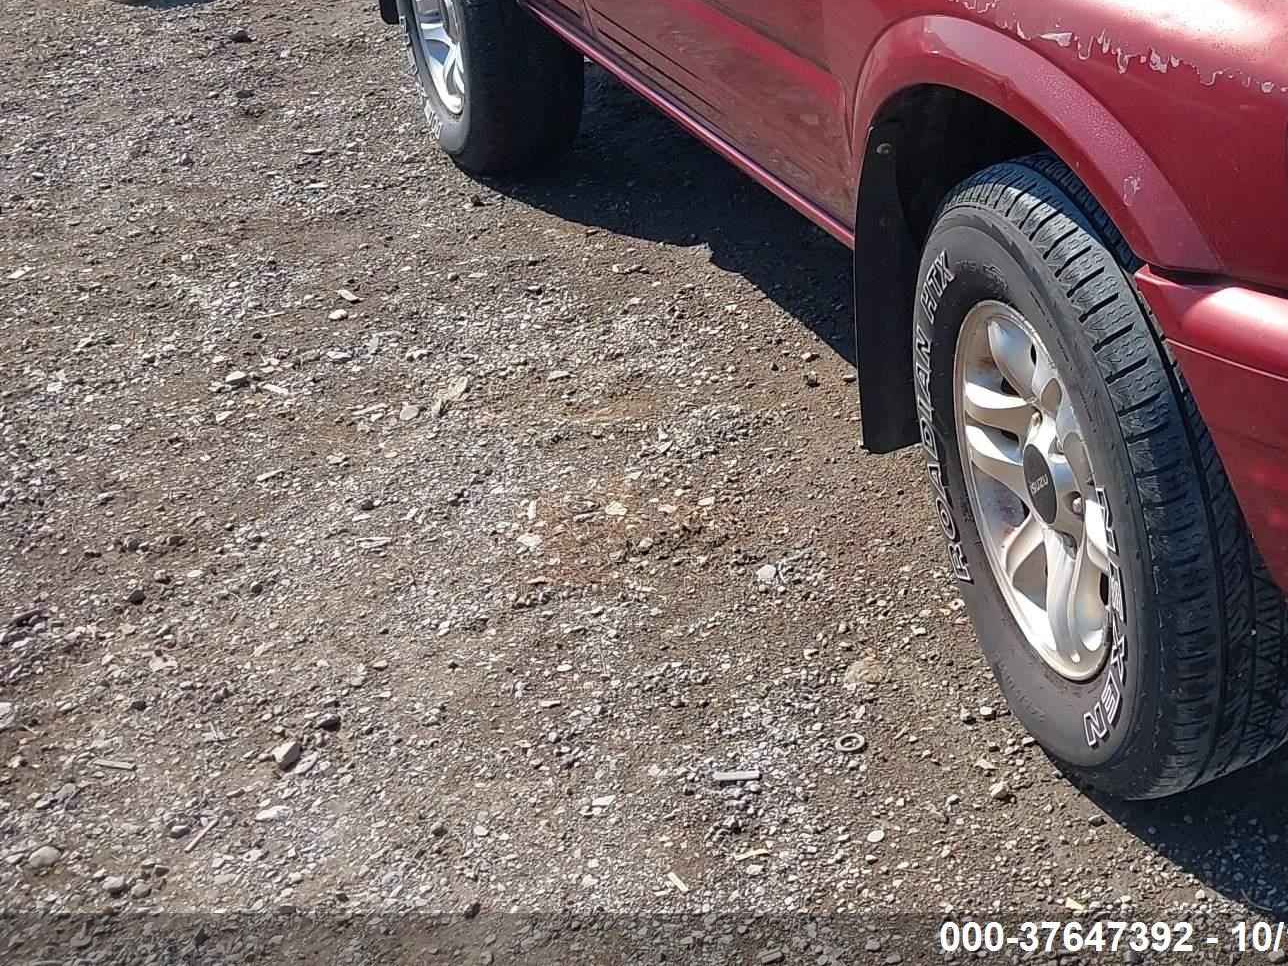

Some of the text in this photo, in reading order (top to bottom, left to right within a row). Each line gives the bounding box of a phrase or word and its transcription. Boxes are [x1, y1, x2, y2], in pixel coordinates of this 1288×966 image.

[920, 248, 955, 325] HTX
[915, 323, 972, 582] ROADIAN
[1028, 474, 1049, 495] ISUZU
